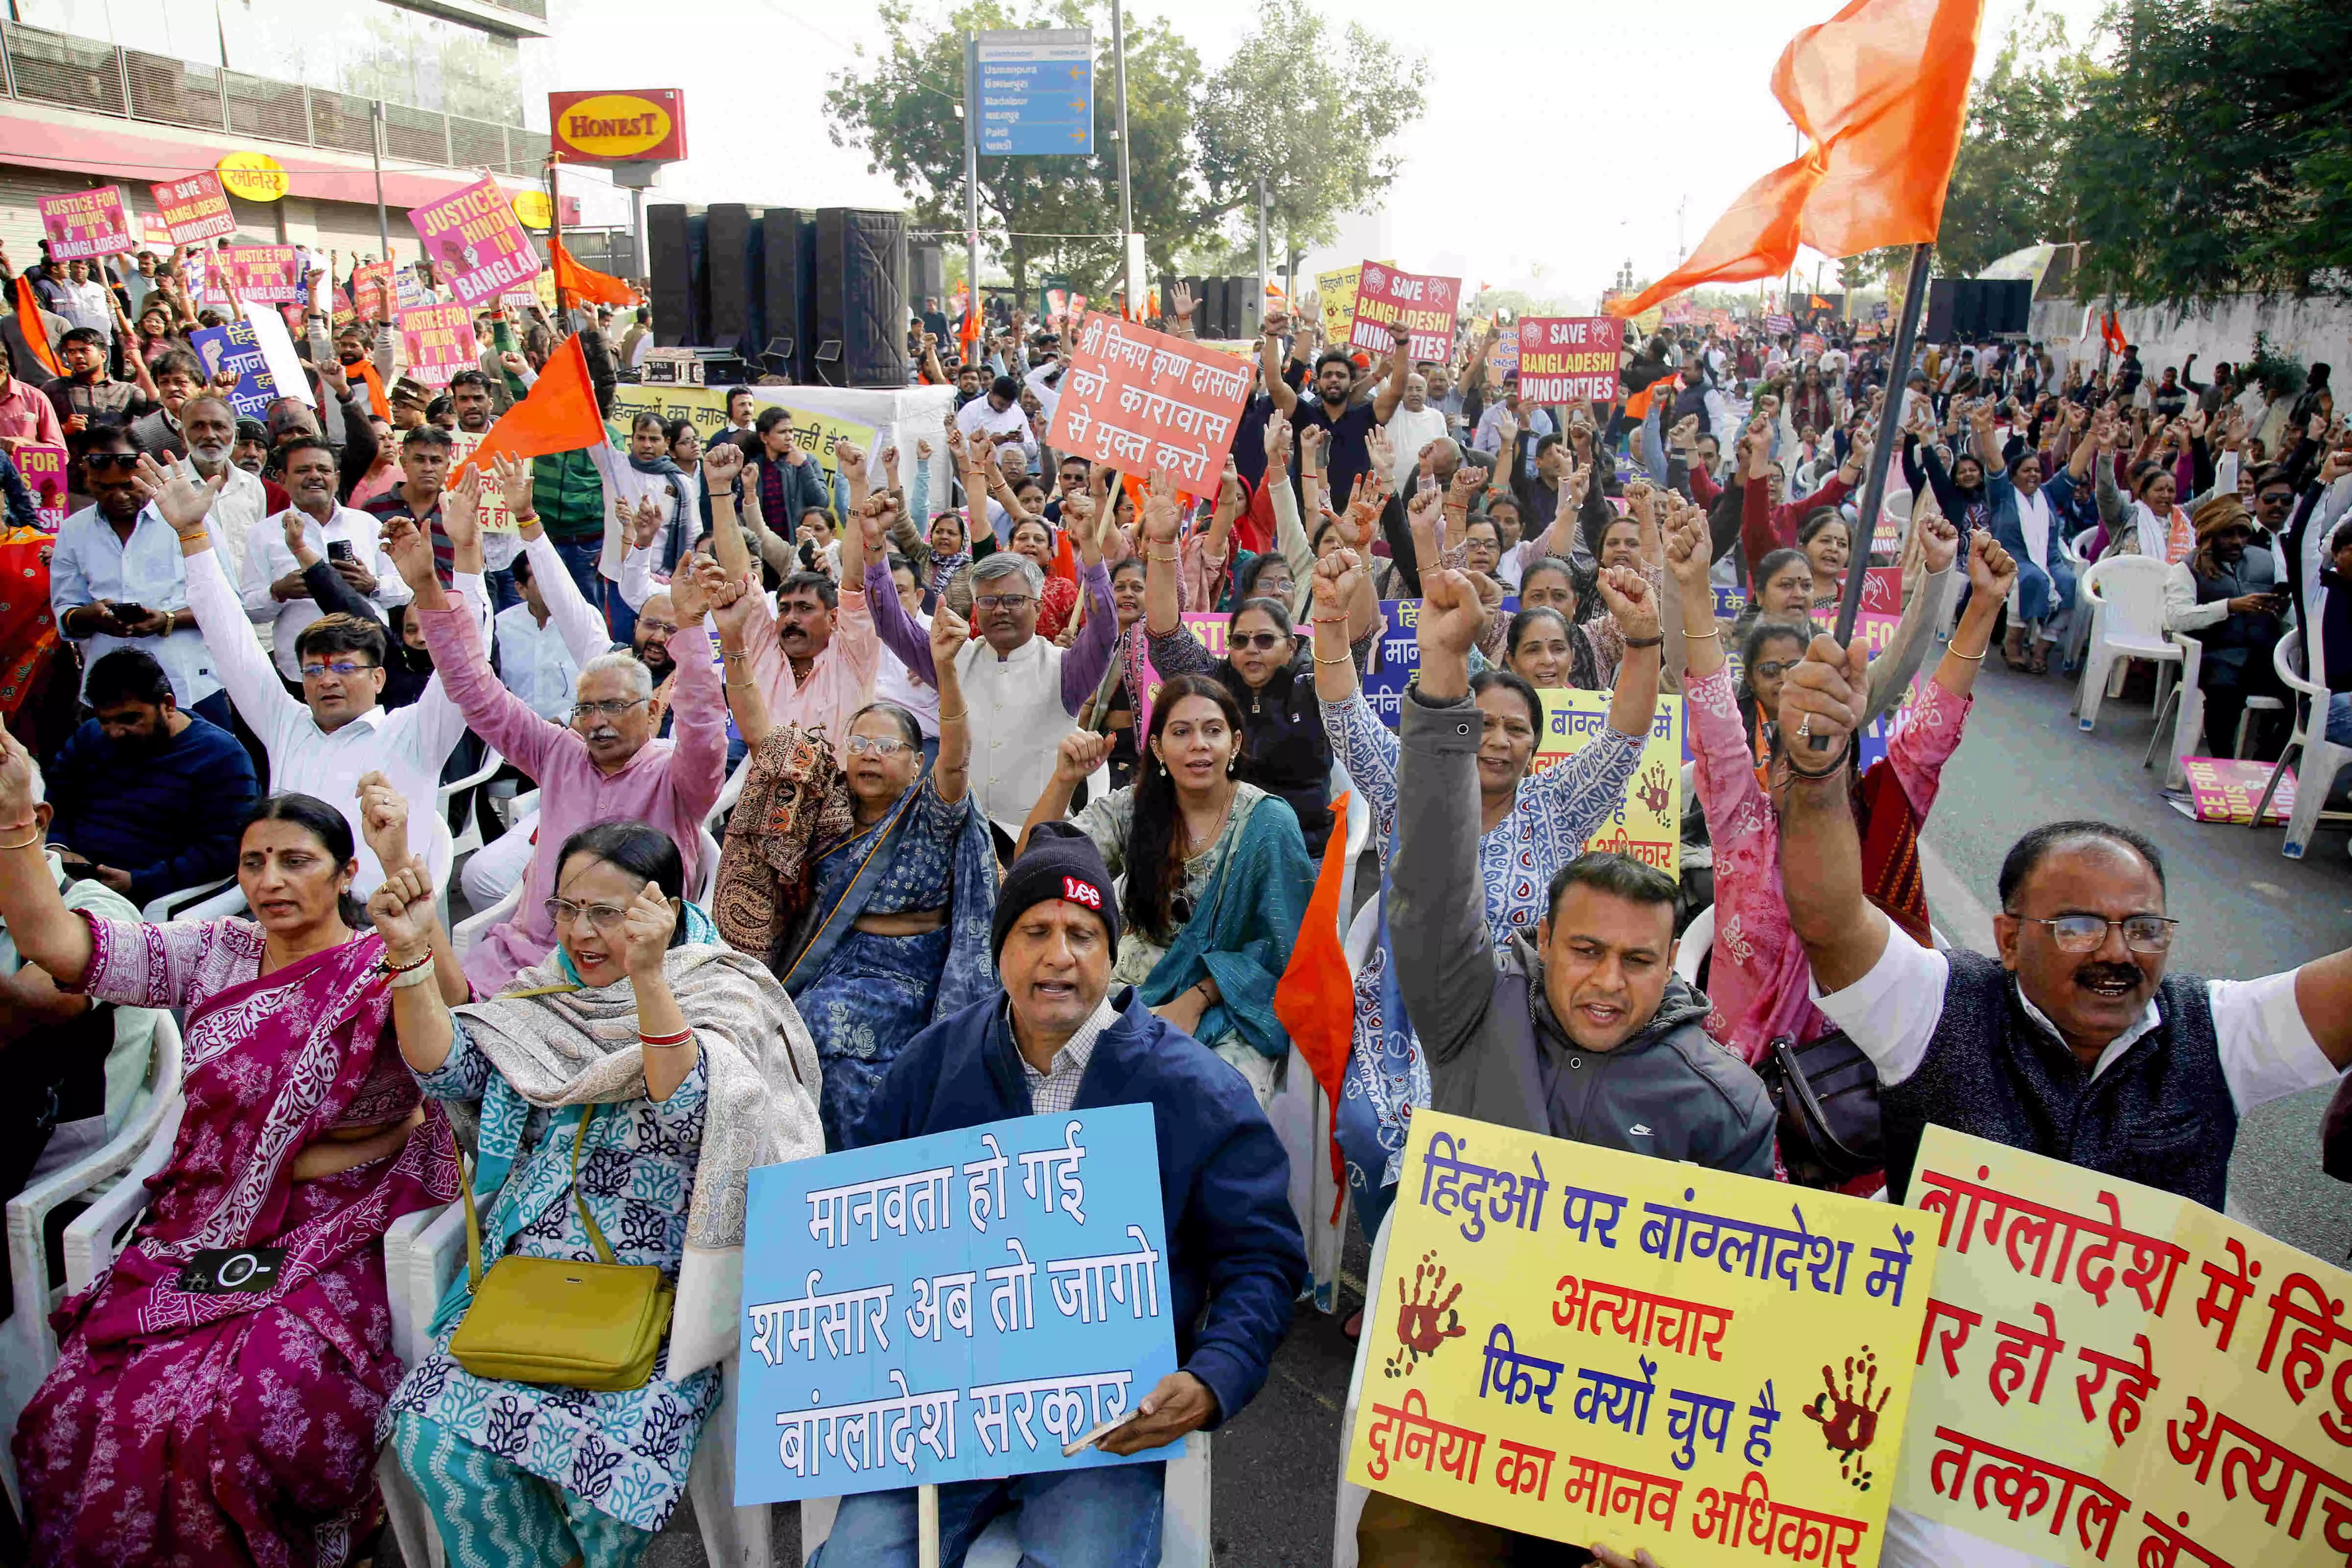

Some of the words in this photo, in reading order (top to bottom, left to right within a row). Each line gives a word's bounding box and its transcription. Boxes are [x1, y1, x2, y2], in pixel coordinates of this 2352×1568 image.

[569, 113, 658, 138] HONEST
[174, 180, 201, 199] SAVE
[45, 196, 94, 216] JUSTICE
[96, 192, 118, 208] FOR
[66, 209, 106, 227] HINDUS
[164, 196, 227, 225] BANGLADESHI
[423, 184, 503, 237] JUSTICE
[84, 225, 97, 238] IN
[170, 214, 233, 245] MINORITIES
[460, 206, 514, 245] HINDU
[54, 234, 129, 258] BANGLADESH
[235, 249, 271, 263] JUSTICE
[274, 249, 294, 261] FOR
[492, 231, 517, 255] IN
[249, 263, 281, 274] HINDUS
[1391, 276, 1423, 301] SAVE
[404, 311, 443, 331] JUSTICE
[444, 307, 468, 328] FOR
[420, 328, 456, 347] HINDUS
[1550, 323, 1587, 344] SAVE
[435, 347, 447, 363] IN
[1081, 318, 1103, 356] श्री
[1101, 323, 1152, 372] चिन्मय
[1152, 348, 1192, 385] कृष्ण
[1192, 365, 1250, 404] दासजी
[1522, 352, 1616, 373] BANGLADESHI
[1521, 377, 1614, 401] MINORITIES
[1073, 364, 1109, 403] को
[1120, 384, 1232, 443] कारावास
[1067, 404, 1092, 442] से
[1095, 420, 1152, 463] मुक्त
[1155, 441, 1210, 482] करो
[20, 452, 59, 472] FOR
[2188, 761, 2223, 791] FOR
[1066, 878, 1100, 906] Lee
[806, 1166, 954, 1249] मानवता
[963, 1133, 1009, 1234] हो
[1018, 1119, 1086, 1225] गई
[1420, 1131, 1549, 1243] हिंदुओ
[1562, 1185, 1627, 1249] पर
[1638, 1187, 1854, 1295] बांग्लादेश
[1865, 1222, 1915, 1307] में
[1919, 1165, 2189, 1317] बांग्लादेश
[2195, 1238, 2261, 1352] में
[749, 1270, 894, 1367] शर्मसार
[905, 1271, 976, 1342] अब
[986, 1237, 1036, 1334] तो
[1047, 1224, 1159, 1324] जागो
[1552, 1274, 1734, 1362] अत्याचार
[1988, 1302, 2065, 1406] हो
[2076, 1334, 2159, 1447] रहे
[1479, 1323, 1564, 1415] फिर
[1573, 1354, 1657, 1436] क्यों
[1667, 1388, 1734, 1472] चुप
[1744, 1379, 1782, 1467] है
[776, 1369, 959, 1477] बांग्लादेश
[969, 1370, 1132, 1457] सरकार
[1366, 1388, 1486, 1481] दुनिया
[1494, 1439, 1556, 1501] का
[1564, 1455, 1683, 1532] मानव
[1692, 1470, 1868, 1568] अधिकार
[1930, 1425, 2132, 1562] तत्काल
